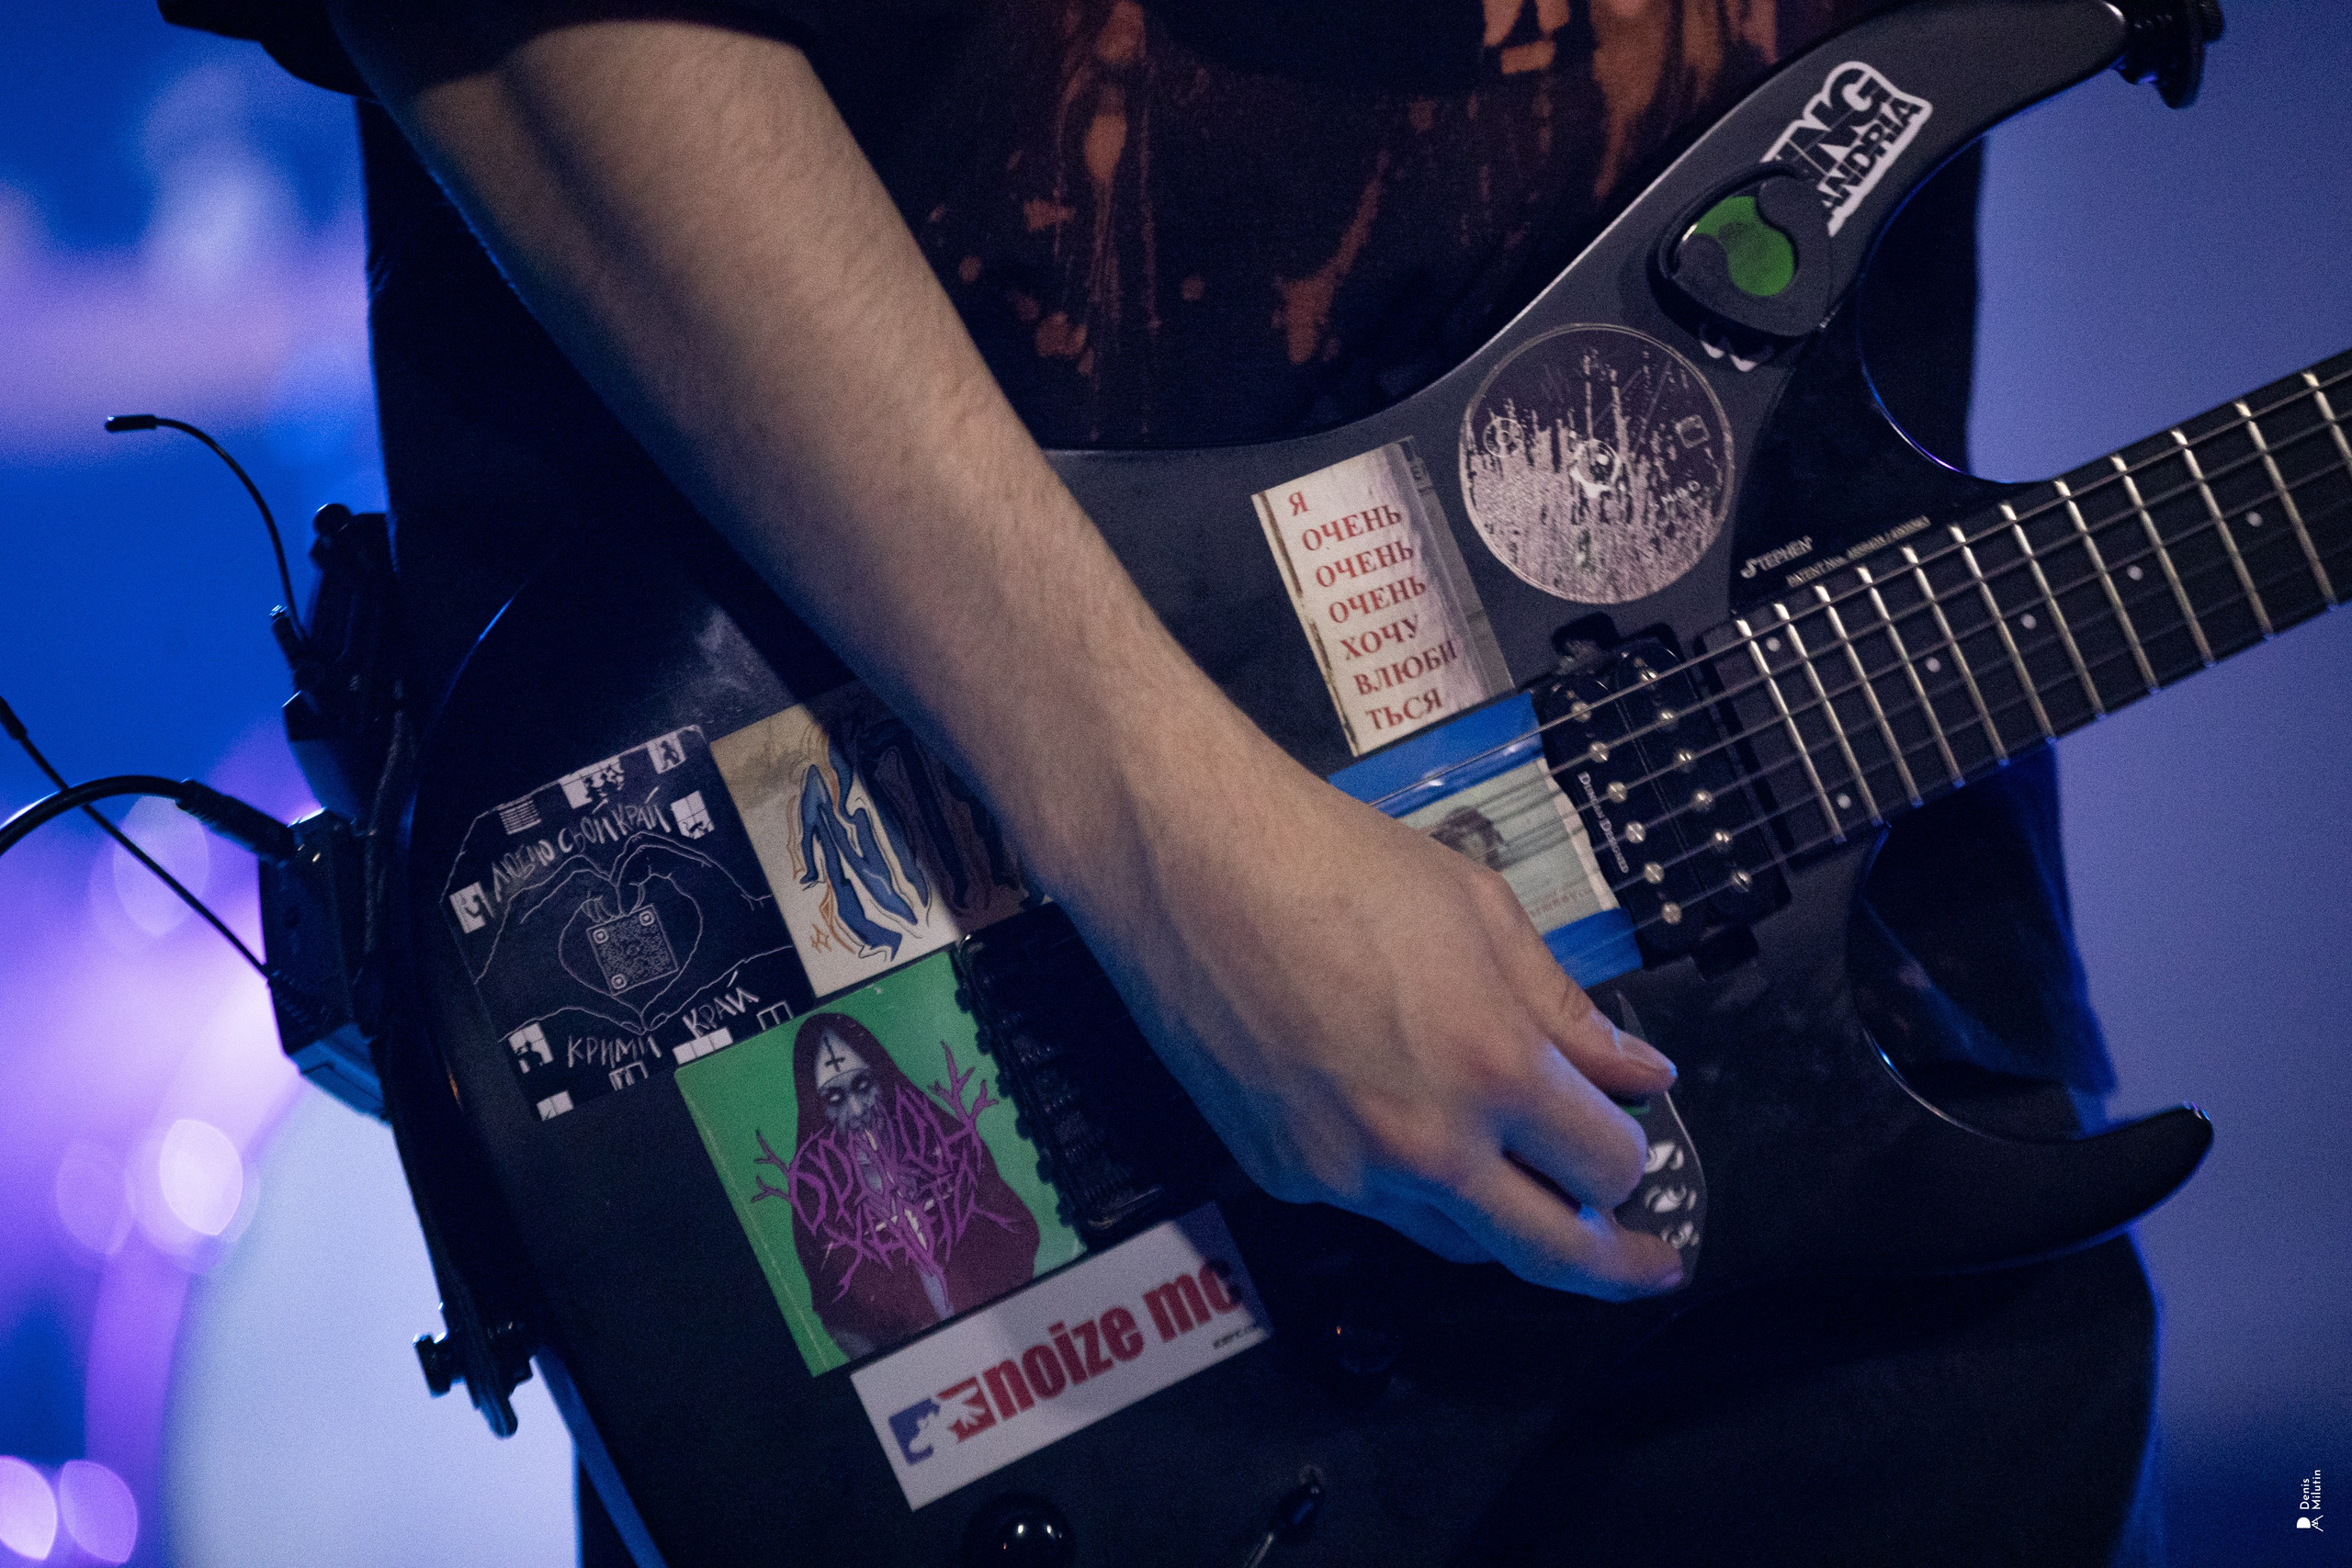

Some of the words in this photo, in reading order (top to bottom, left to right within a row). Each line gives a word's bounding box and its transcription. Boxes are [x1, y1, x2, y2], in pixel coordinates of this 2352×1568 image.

[1773, 68, 1893, 180] ING
[1819, 96, 1923, 217] ANDRIA
[1288, 491, 1308, 516] Я
[1301, 504, 1402, 551] ОЧЕНЬ
[1315, 540, 1415, 587] ОЧЕНЬ
[1329, 575, 1427, 624] ОЧЕНЬ
[1340, 614, 1419, 660] ХОЧУ
[1352, 640, 1458, 696] ВЛЮБИ
[1364, 688, 1443, 730] ТЬСЯ
[683, 970, 760, 1039] КРАЙ
[982, 1306, 1145, 1420] noize
[1143, 1259, 1243, 1343] mc
